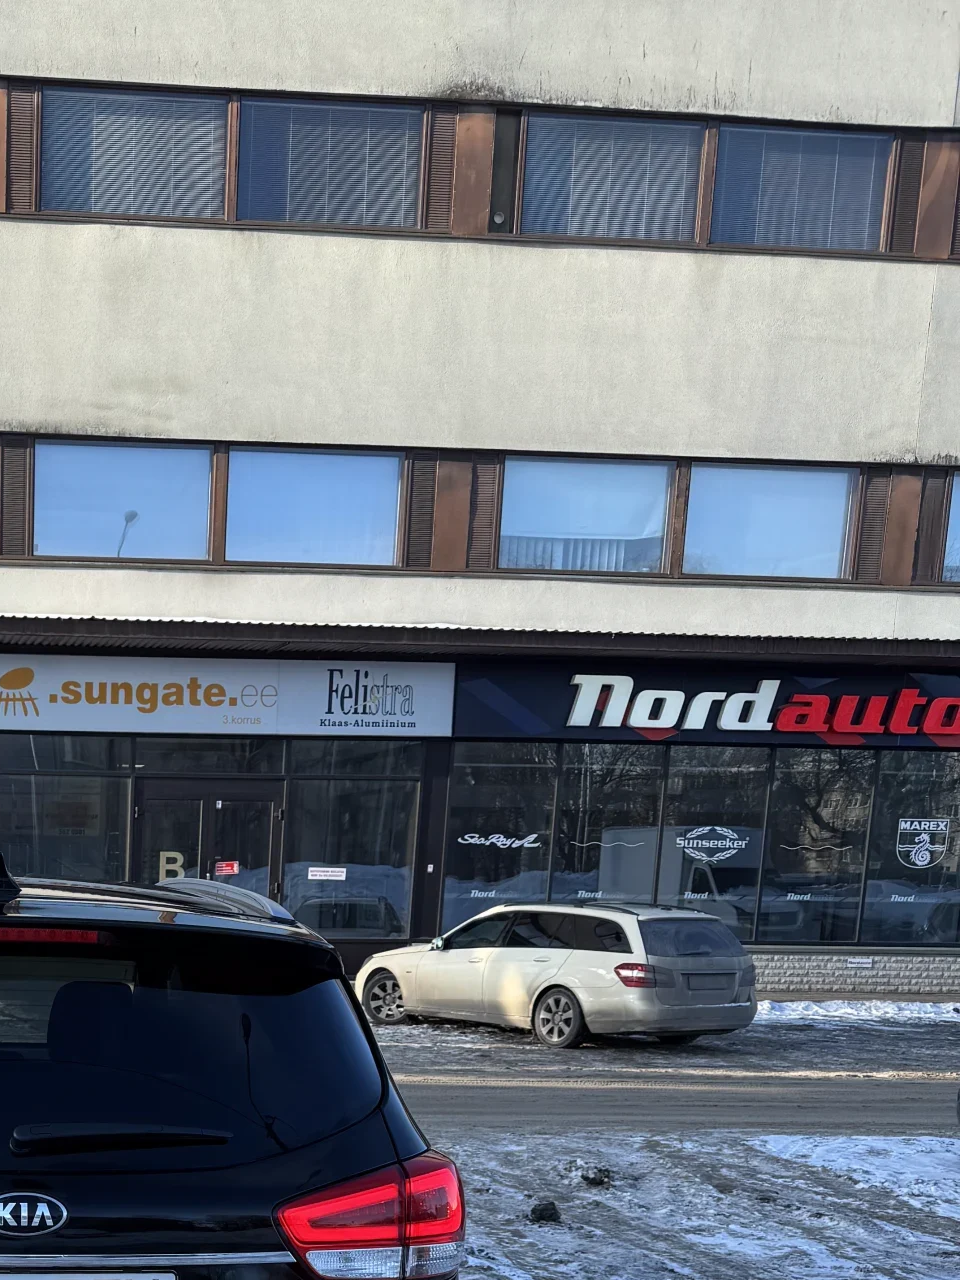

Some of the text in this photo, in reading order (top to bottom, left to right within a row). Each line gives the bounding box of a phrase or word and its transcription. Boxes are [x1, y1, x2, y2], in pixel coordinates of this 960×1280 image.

[324, 668, 415, 716] Felistra
[222, 714, 261, 725] 3.korrus
[319, 718, 417, 729] Klaas-Alumiinium
[900, 821, 947, 831] MAREX
[159, 851, 185, 882] B
